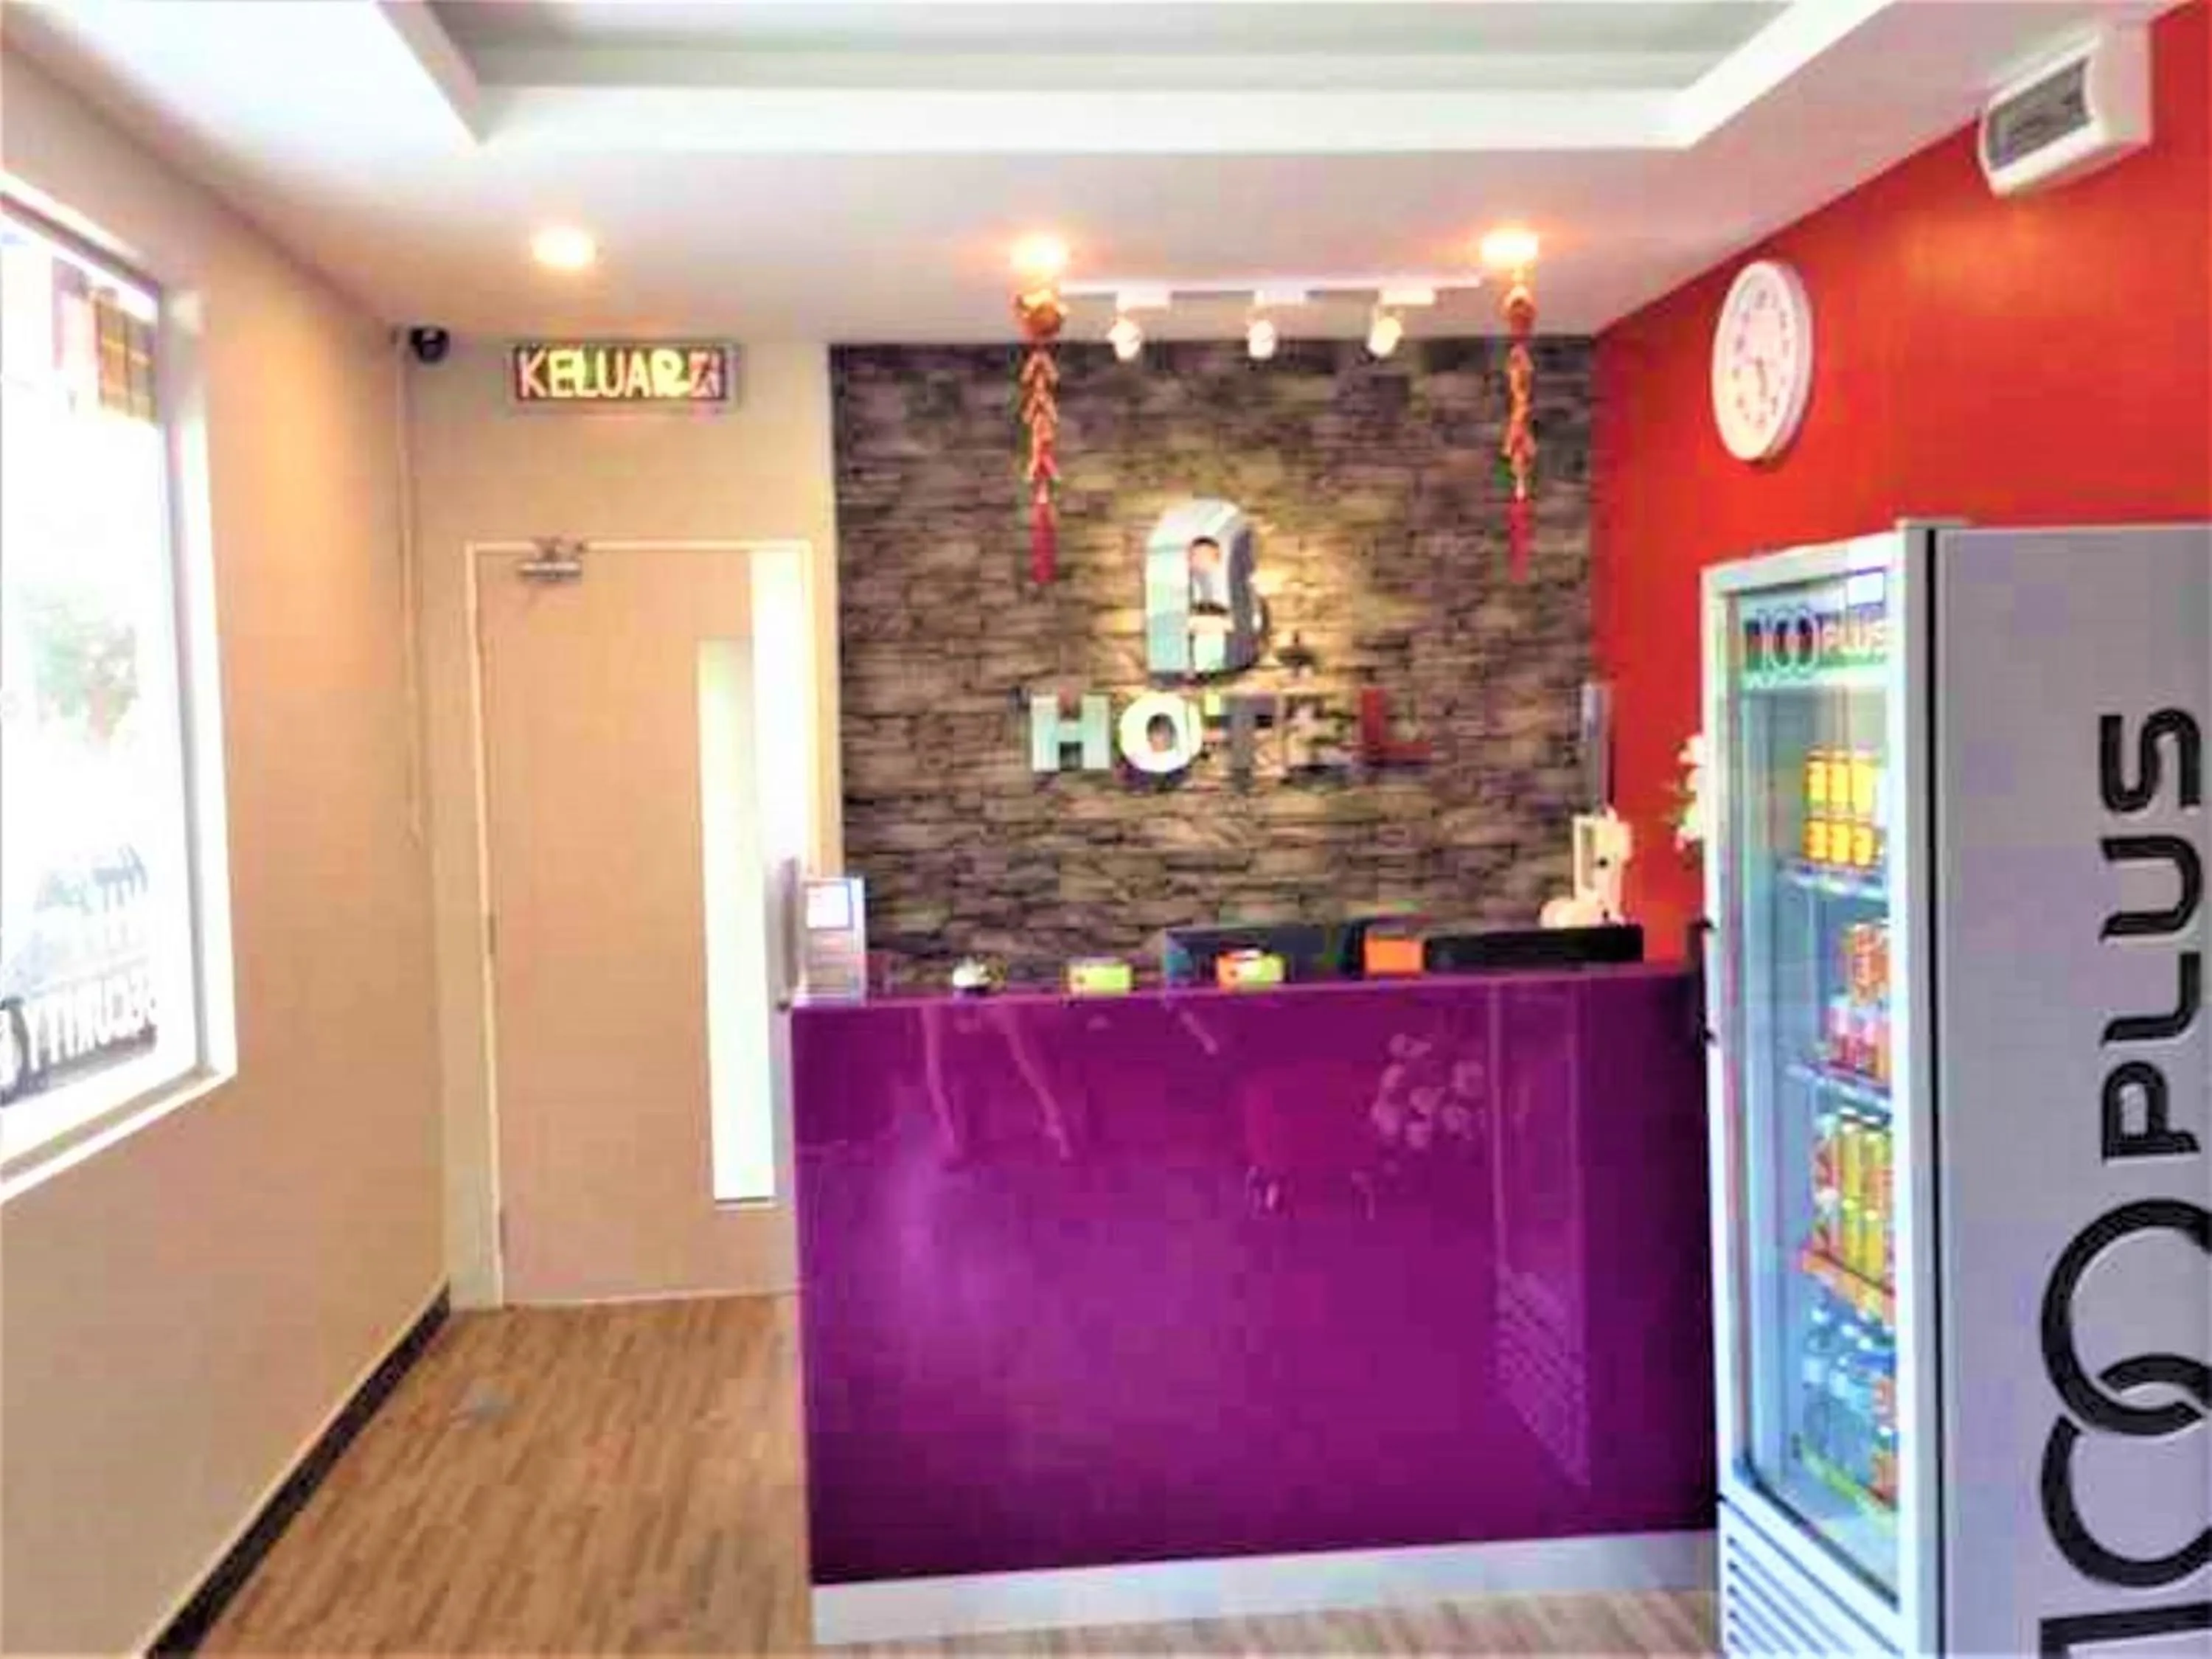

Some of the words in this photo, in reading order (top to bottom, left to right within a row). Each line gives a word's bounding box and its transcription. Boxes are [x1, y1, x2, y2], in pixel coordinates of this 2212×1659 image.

[519, 349, 692, 398] KELUAR
[1031, 689, 1432, 774] HOTL
[2100, 708, 2205, 1164] PLUS
